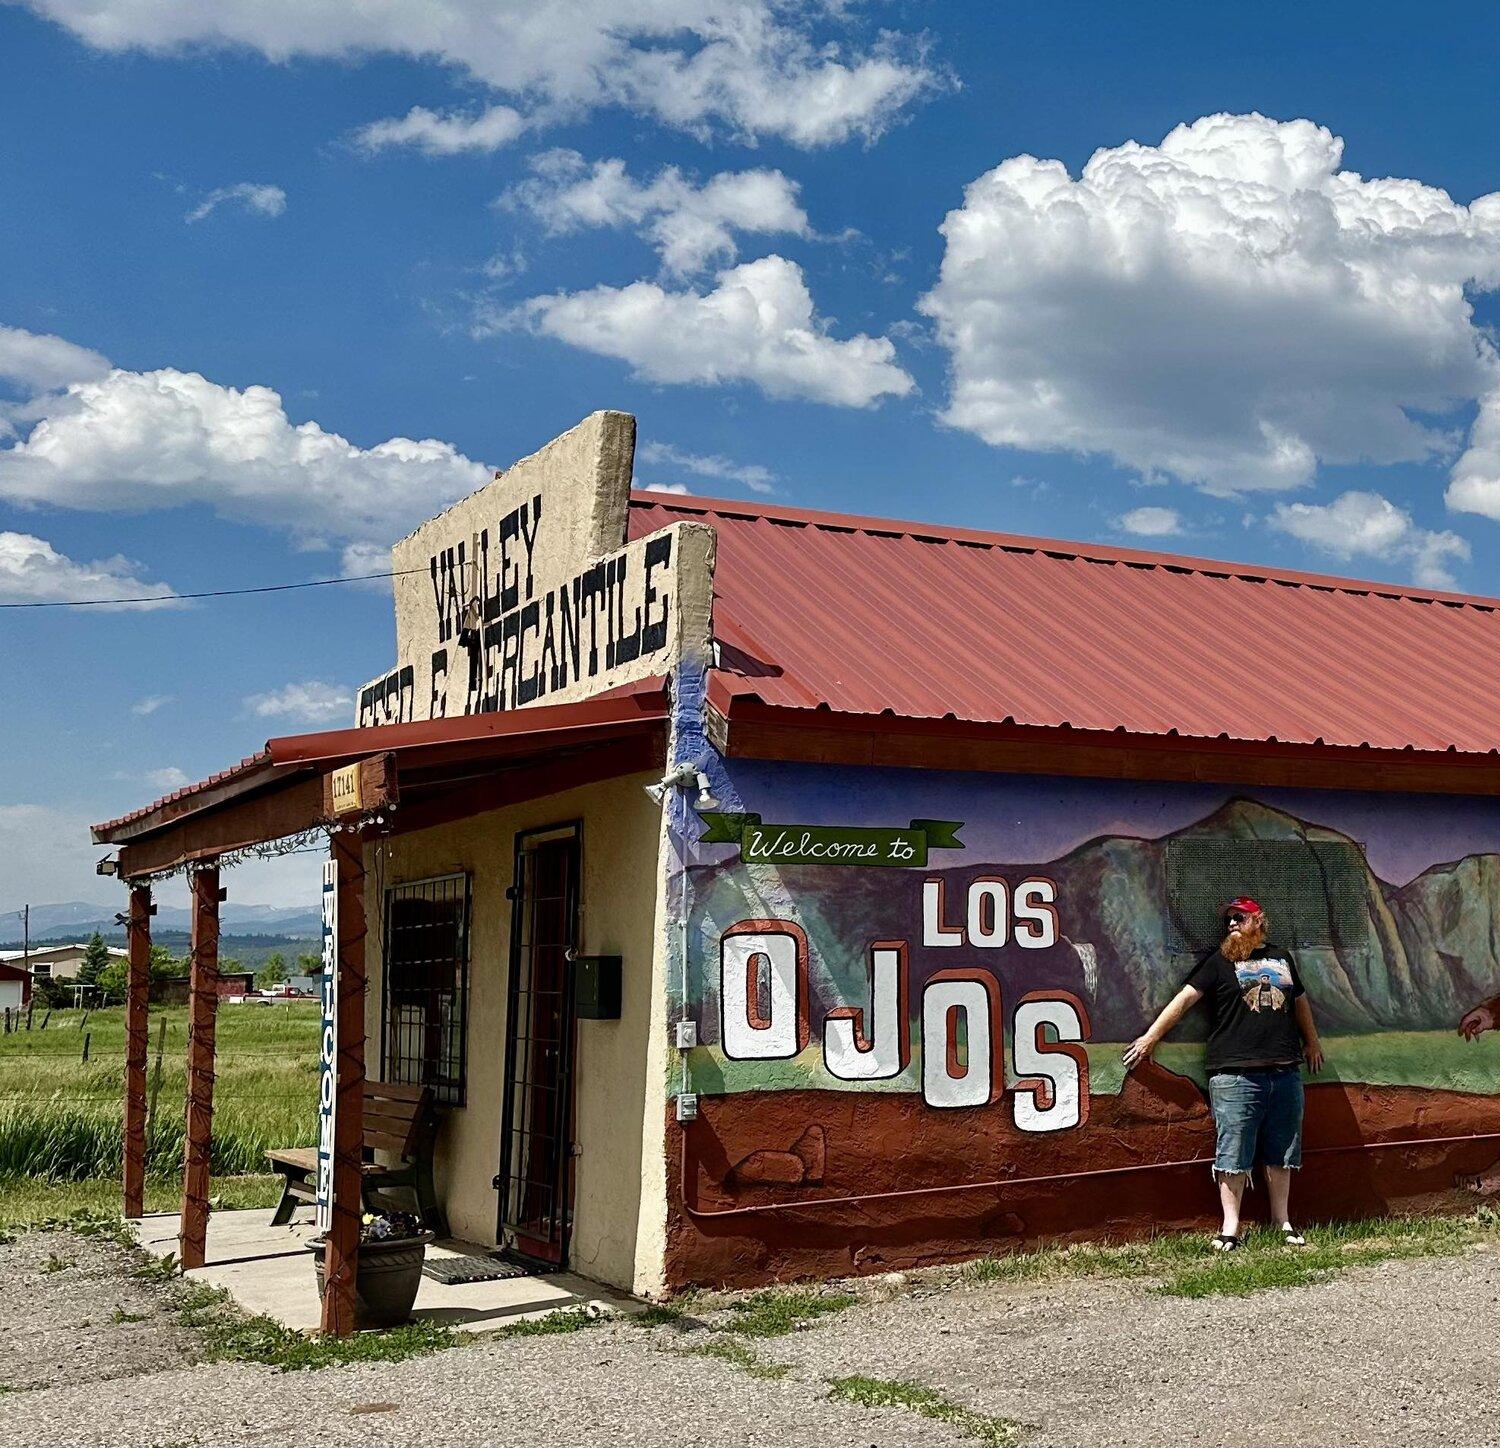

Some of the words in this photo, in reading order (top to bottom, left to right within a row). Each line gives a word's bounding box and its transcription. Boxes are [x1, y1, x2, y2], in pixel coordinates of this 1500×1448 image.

[430, 493, 541, 644] VALLEY
[333, 774, 355, 798] 17141
[750, 830, 878, 858] Welcome
[887, 837, 916, 860] to
[922, 876, 1059, 949] LOS
[316, 891, 335, 1200] WELCOME
[718, 918, 1093, 1132] OJOS
